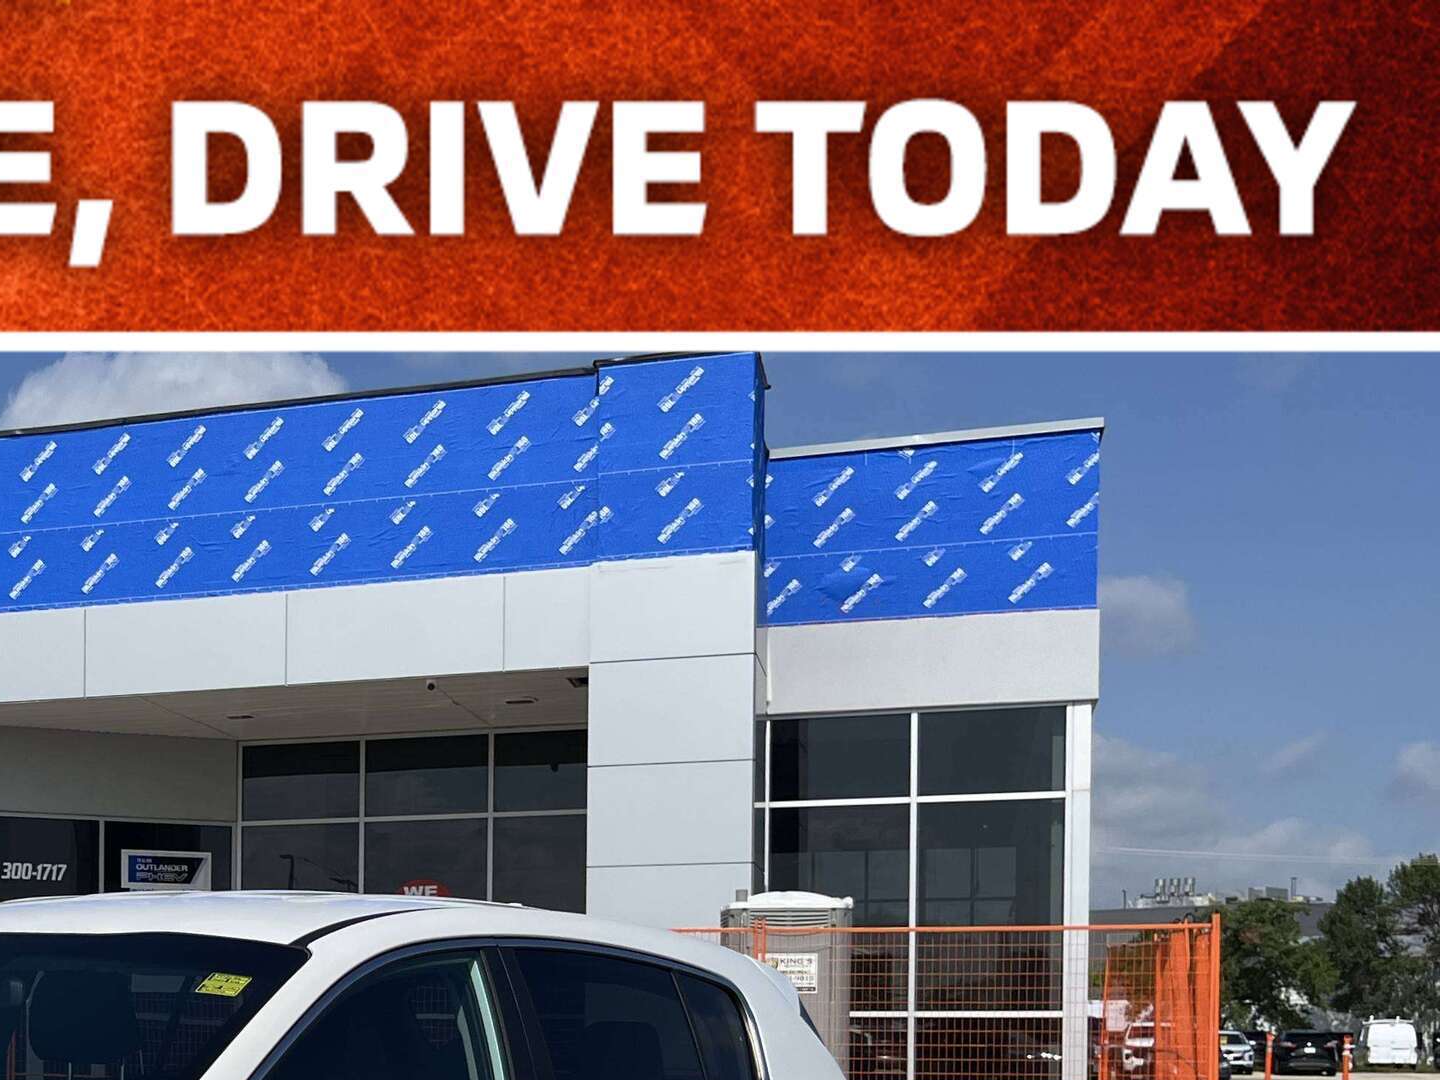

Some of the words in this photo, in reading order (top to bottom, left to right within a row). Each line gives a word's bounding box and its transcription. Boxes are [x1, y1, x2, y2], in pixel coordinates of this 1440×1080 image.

[1, 862, 67, 881] 300-1717
[136, 863, 188, 872] OUTLANDER
[403, 885, 438, 897] WE
